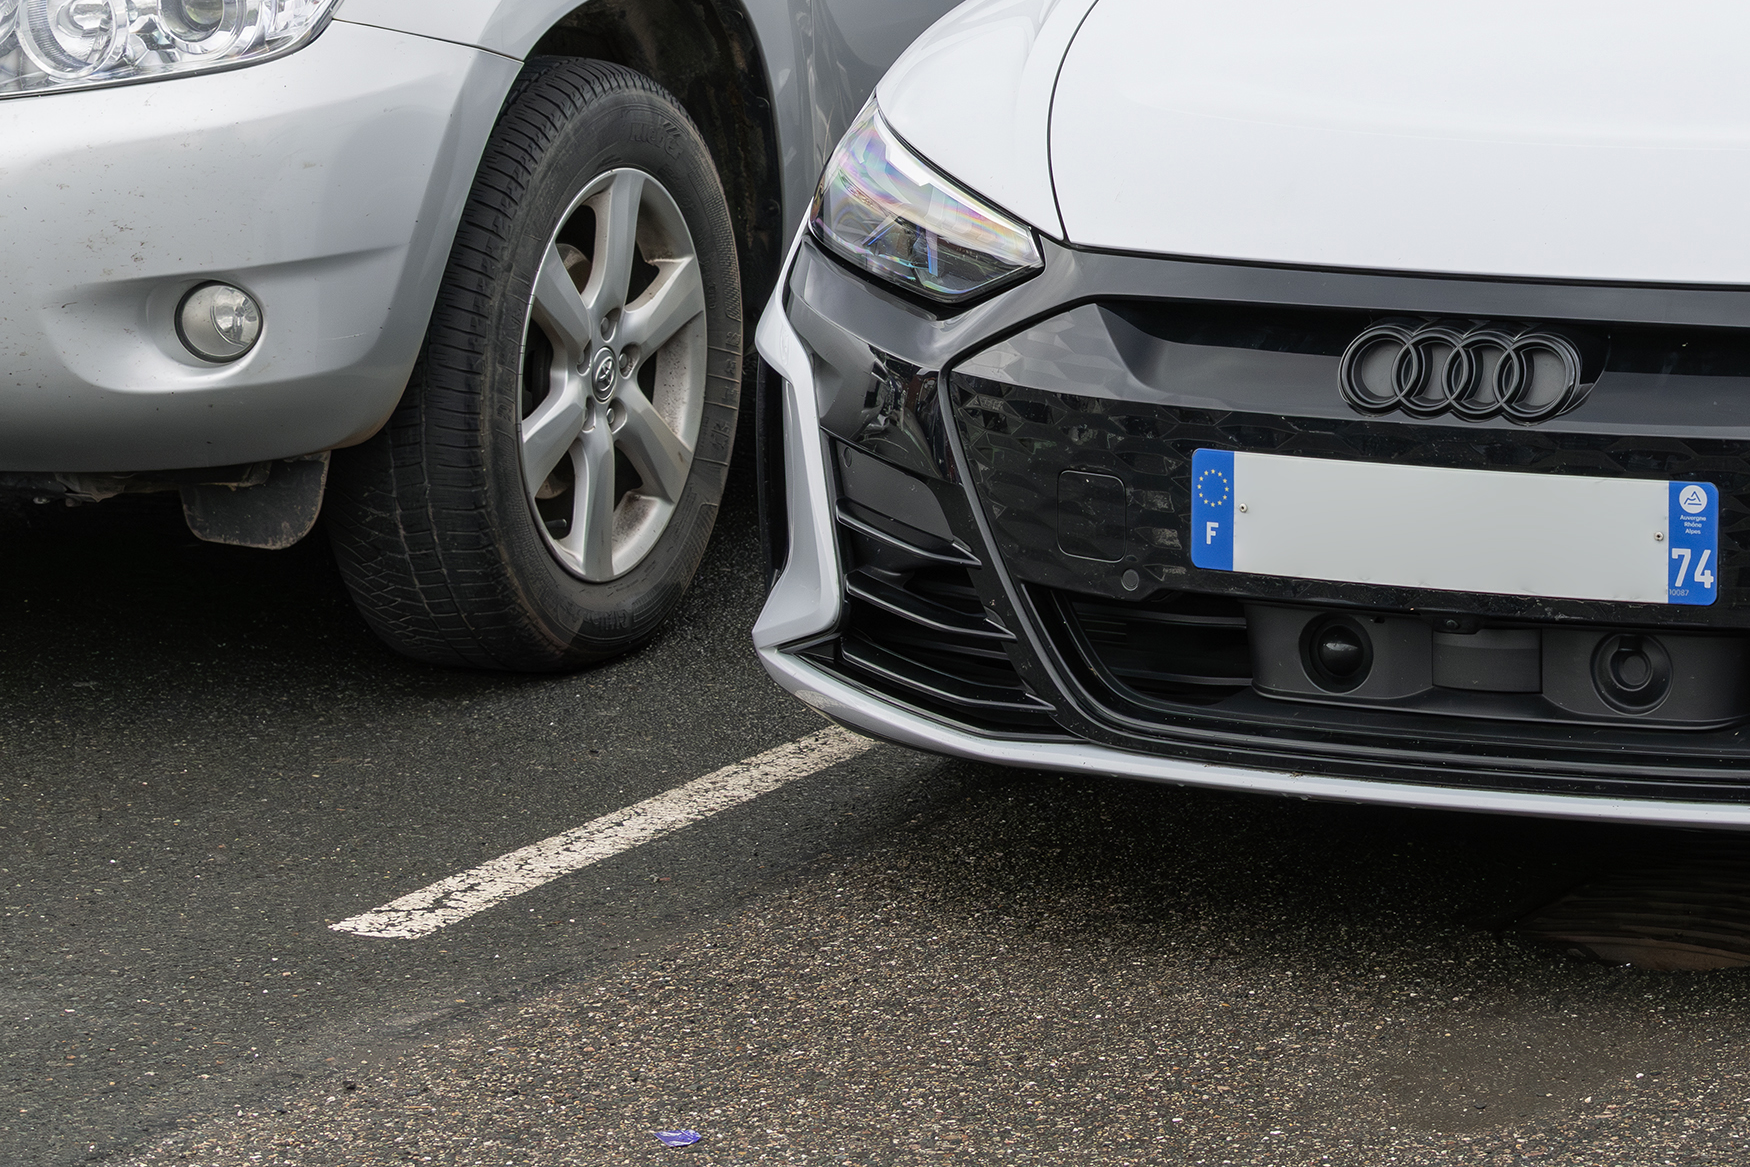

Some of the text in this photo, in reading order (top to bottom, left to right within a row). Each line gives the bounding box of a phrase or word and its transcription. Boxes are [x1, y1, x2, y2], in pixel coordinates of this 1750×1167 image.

[1679, 514, 1707, 522] Auvergne
[1206, 521, 1219, 545] F
[1671, 547, 1714, 589] 74
[1669, 588, 1689, 597] 10087
